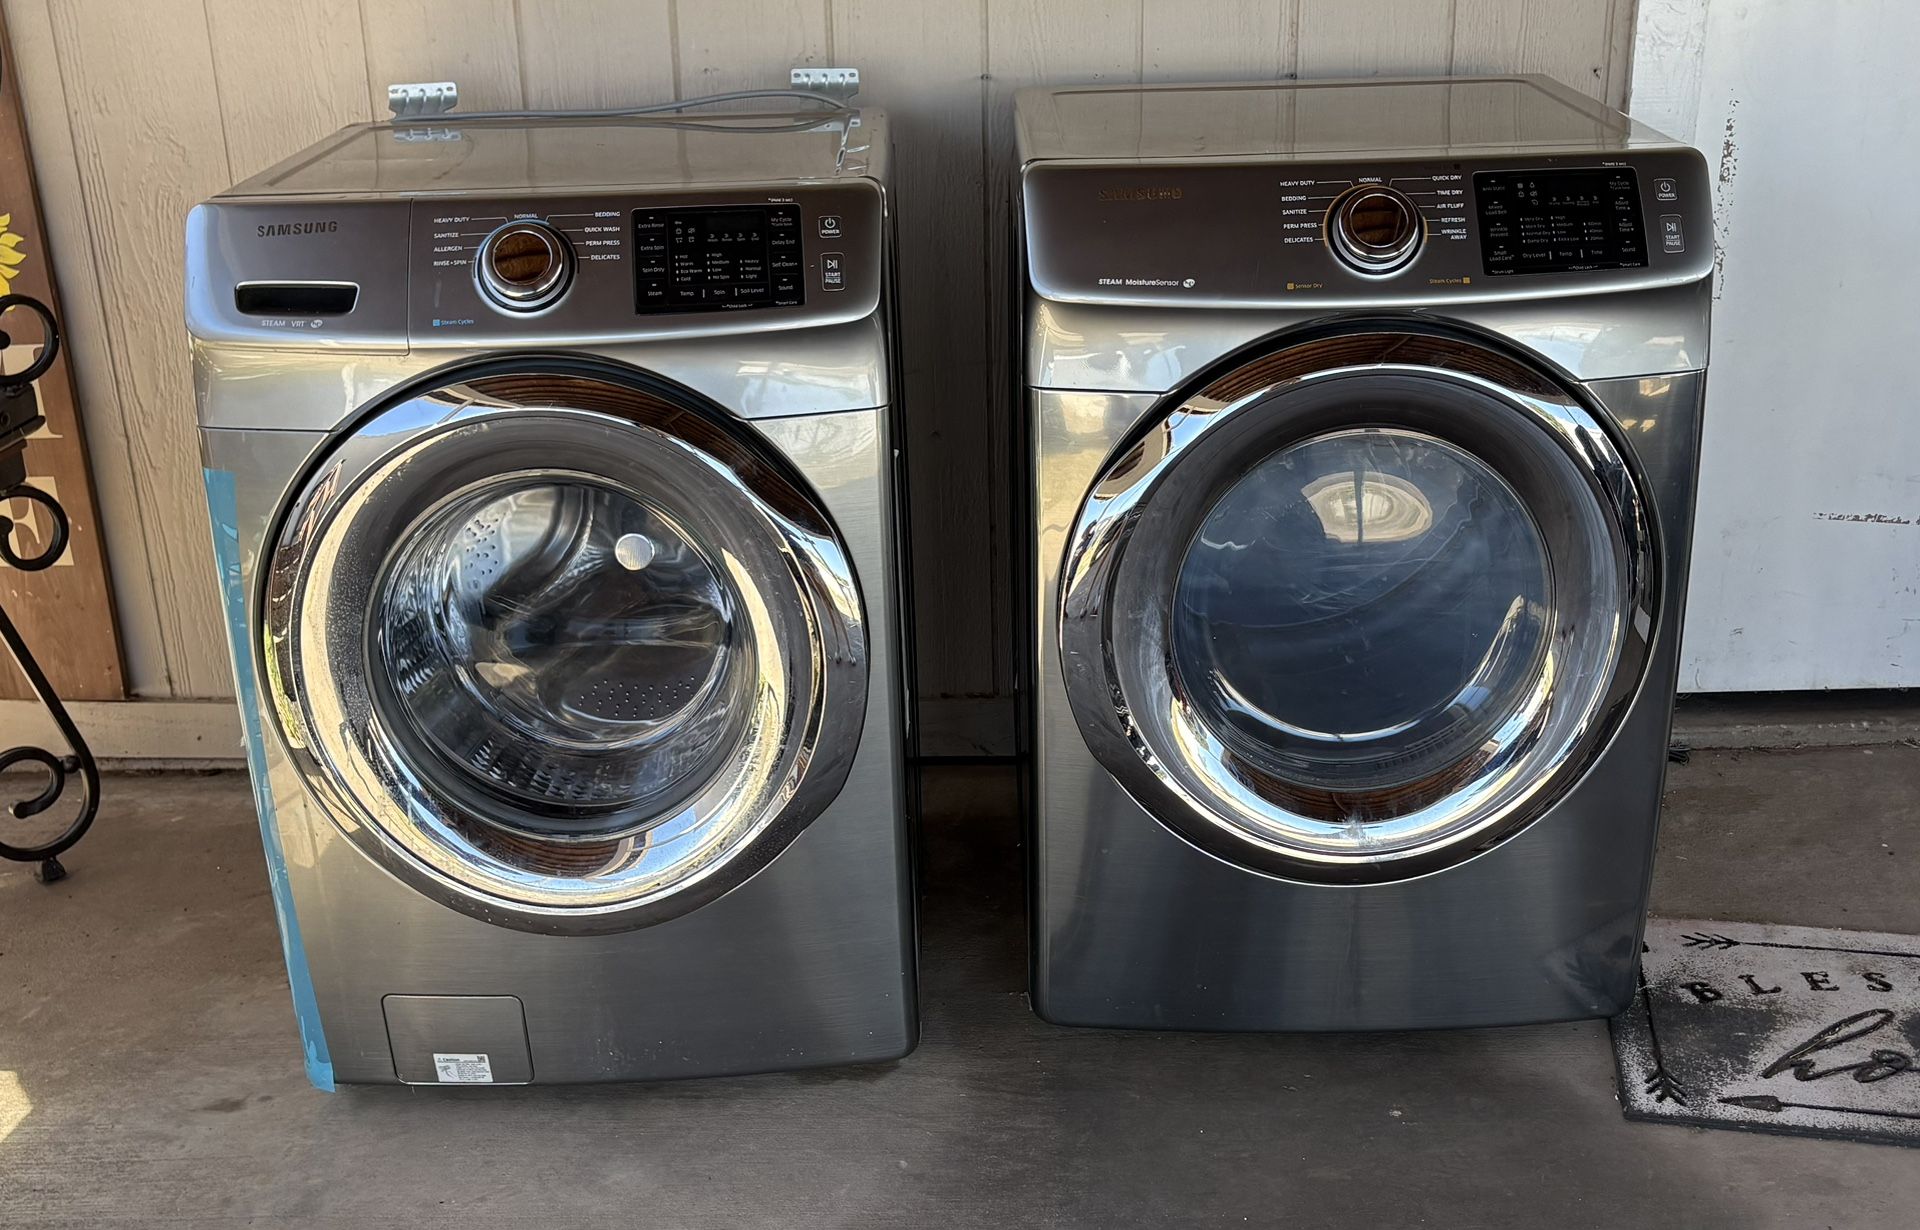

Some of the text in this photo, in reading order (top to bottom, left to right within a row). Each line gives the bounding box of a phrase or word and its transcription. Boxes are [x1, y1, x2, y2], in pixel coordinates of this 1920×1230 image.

[257, 220, 338, 238] SAMSUNG
[1126, 278, 1180, 286] MoistureSensor
[262, 320, 286, 328] STEAM
[1679, 971, 1920, 1003] BLES
